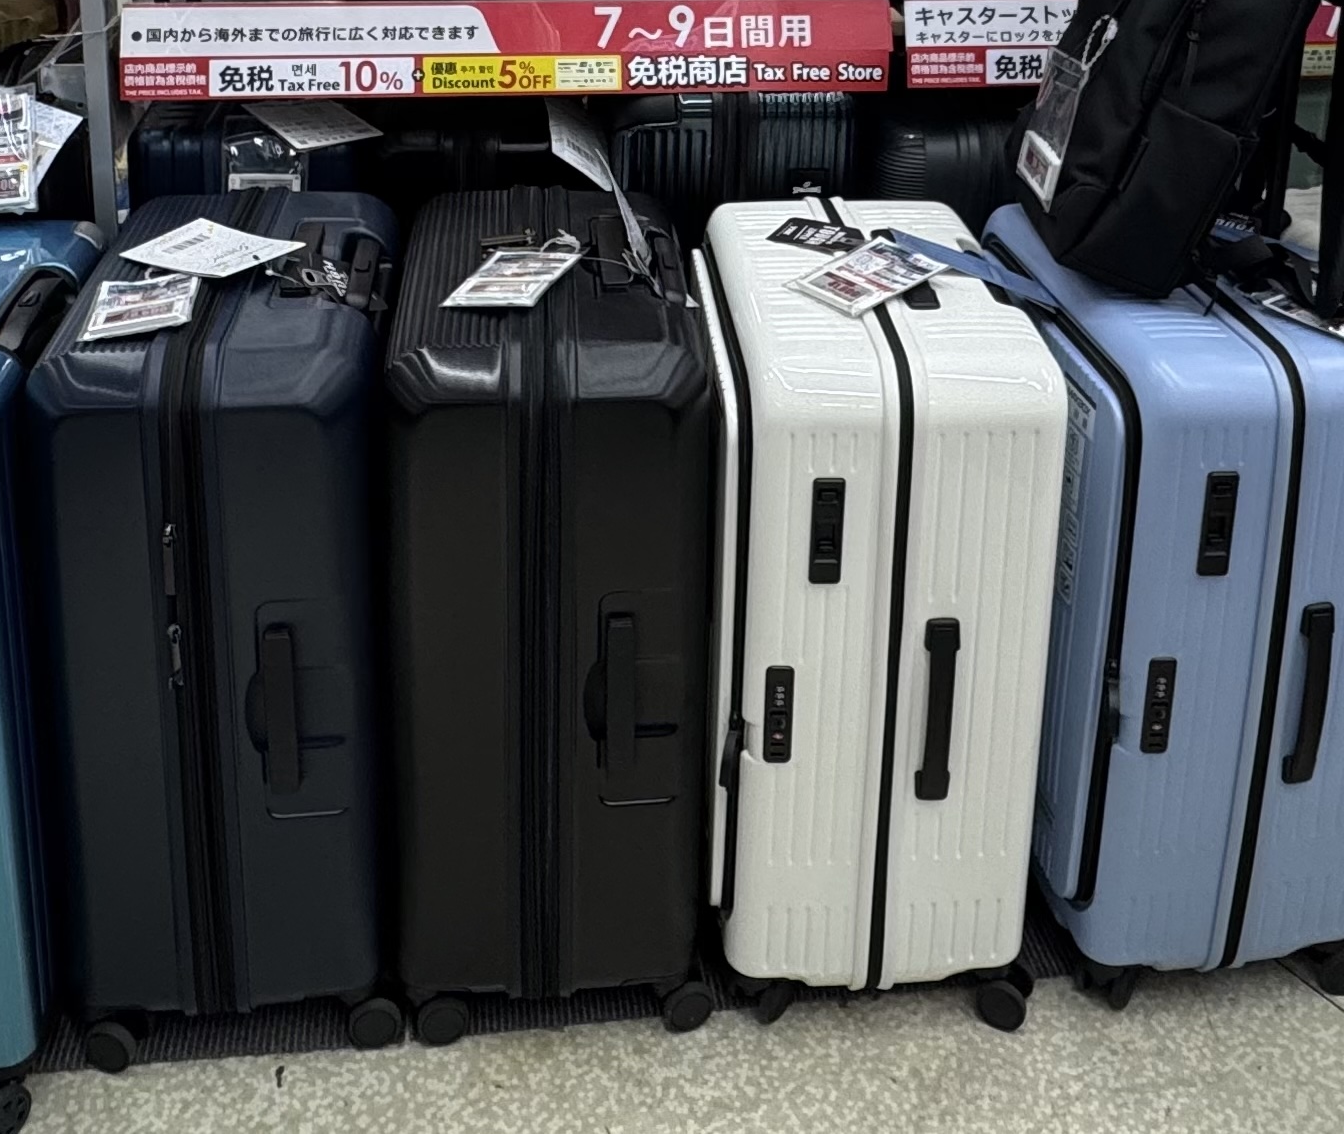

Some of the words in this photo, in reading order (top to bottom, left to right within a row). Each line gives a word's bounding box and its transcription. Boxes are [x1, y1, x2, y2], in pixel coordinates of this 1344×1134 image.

[145, 26, 479, 43] 国内から海外までの旅行に広く対応できます
[593, 5, 813, 49] 7～9日間用
[340, 60, 404, 93] 10%
[628, 56, 748, 87] 免税商店
[755, 63, 786, 81] Tax
[792, 63, 830, 81] Free
[837, 63, 883, 81] Store
[994, 54, 1043, 79] 免税
[218, 66, 274, 93] 免税
[278, 78, 305, 92] Tax
[309, 78, 340, 92] Free
[432, 76, 495, 90] Discount
[519, 75, 552, 89] OFF
